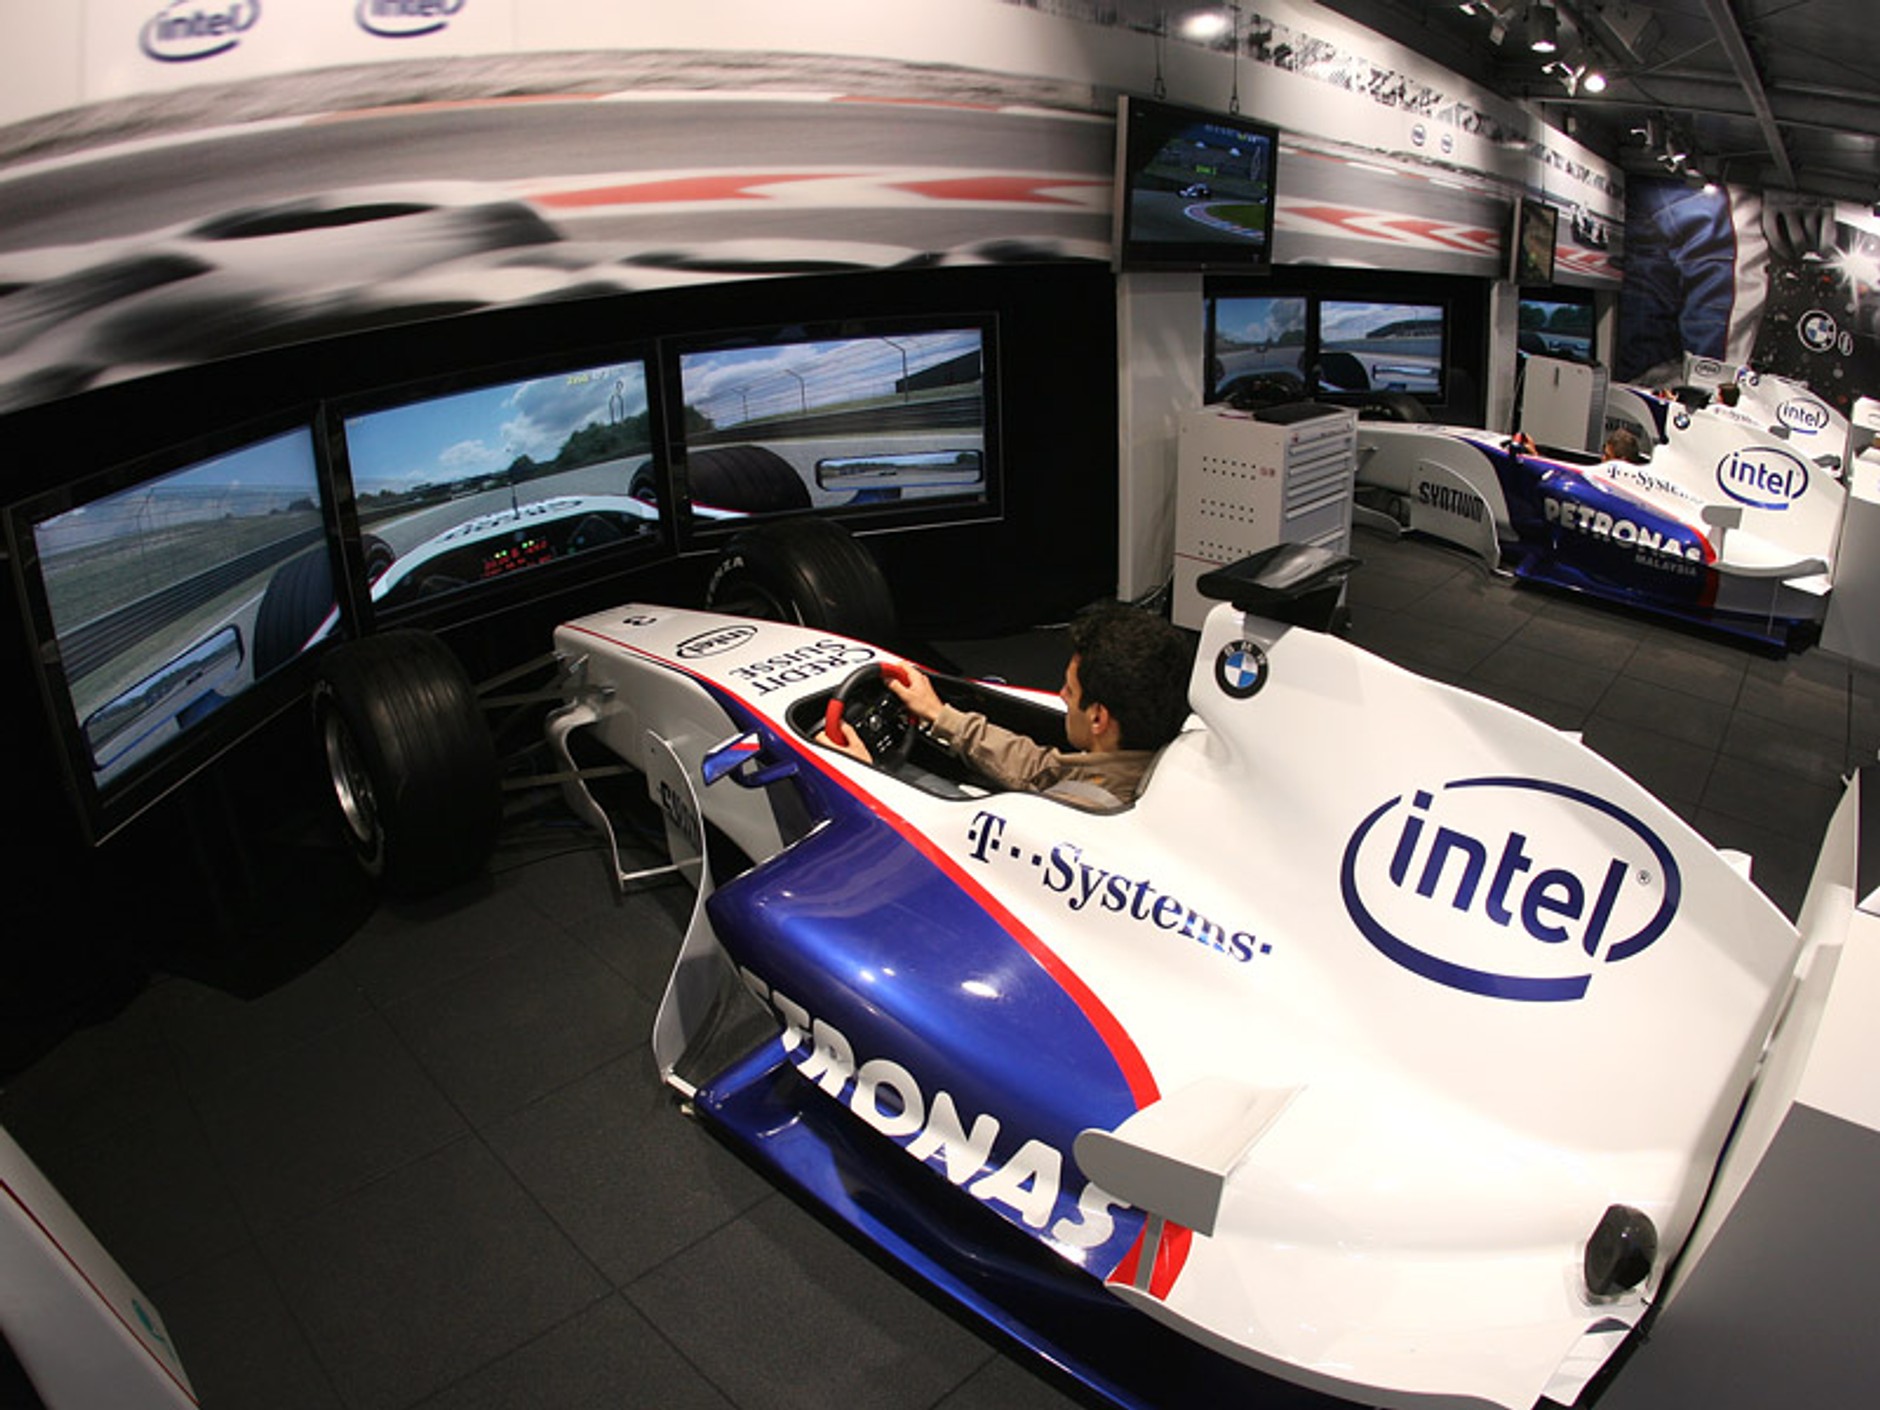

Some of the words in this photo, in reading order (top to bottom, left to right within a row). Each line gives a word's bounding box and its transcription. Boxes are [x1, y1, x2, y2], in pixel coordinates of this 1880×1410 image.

[1783, 401, 1820, 427] intel
[1730, 451, 1794, 497] intel
[728, 639, 846, 680] SUISSE
[751, 647, 876, 696] CREDIT
[1389, 789, 1629, 957] intel
[740, 966, 1131, 1250] TRONAS
